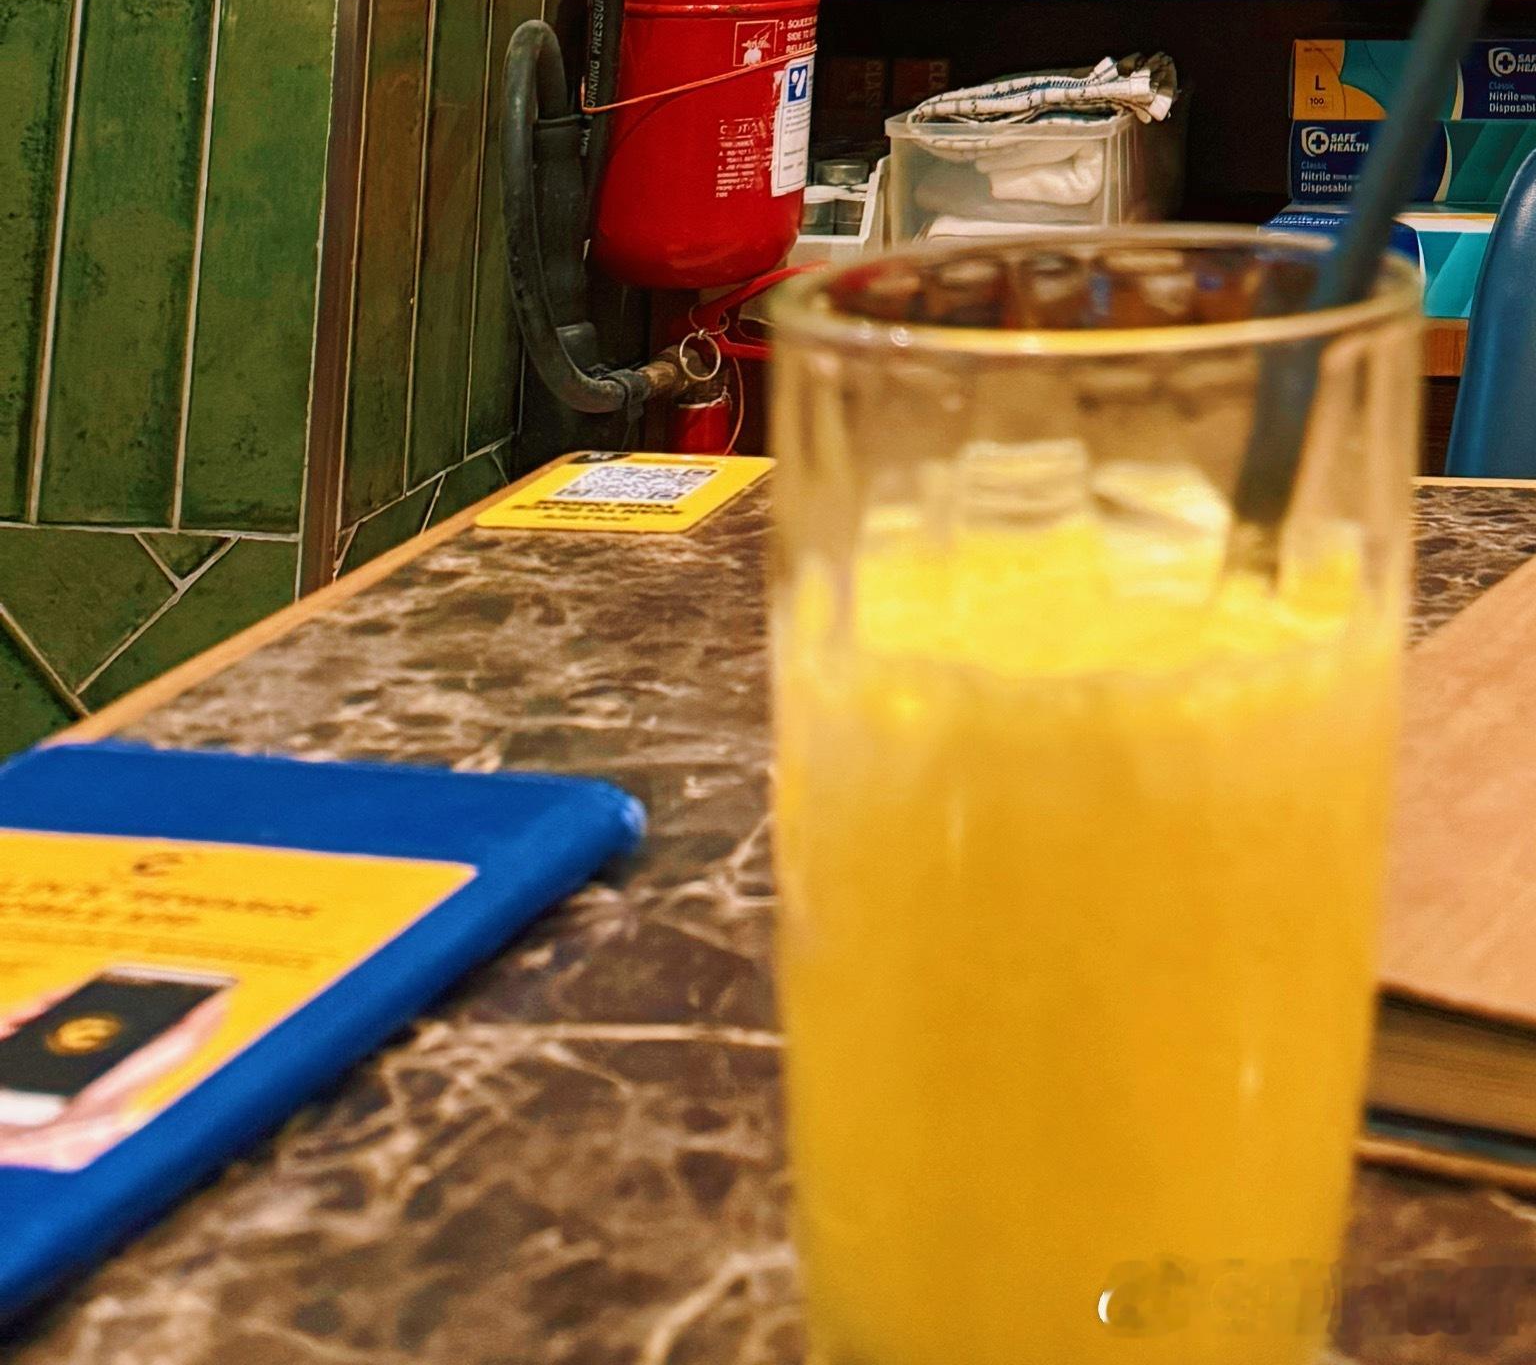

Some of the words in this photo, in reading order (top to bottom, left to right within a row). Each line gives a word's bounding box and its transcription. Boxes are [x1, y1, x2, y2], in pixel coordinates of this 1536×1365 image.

[1315, 75, 1326, 91] L
[1309, 97, 1325, 105] 100
[1489, 91, 1520, 102] Nitrile
[1330, 133, 1357, 143] SAFE
[1329, 143, 1370, 153] HEALTH
[1301, 171, 1331, 182] Nitrile
[1301, 182, 1353, 194] Disposable
